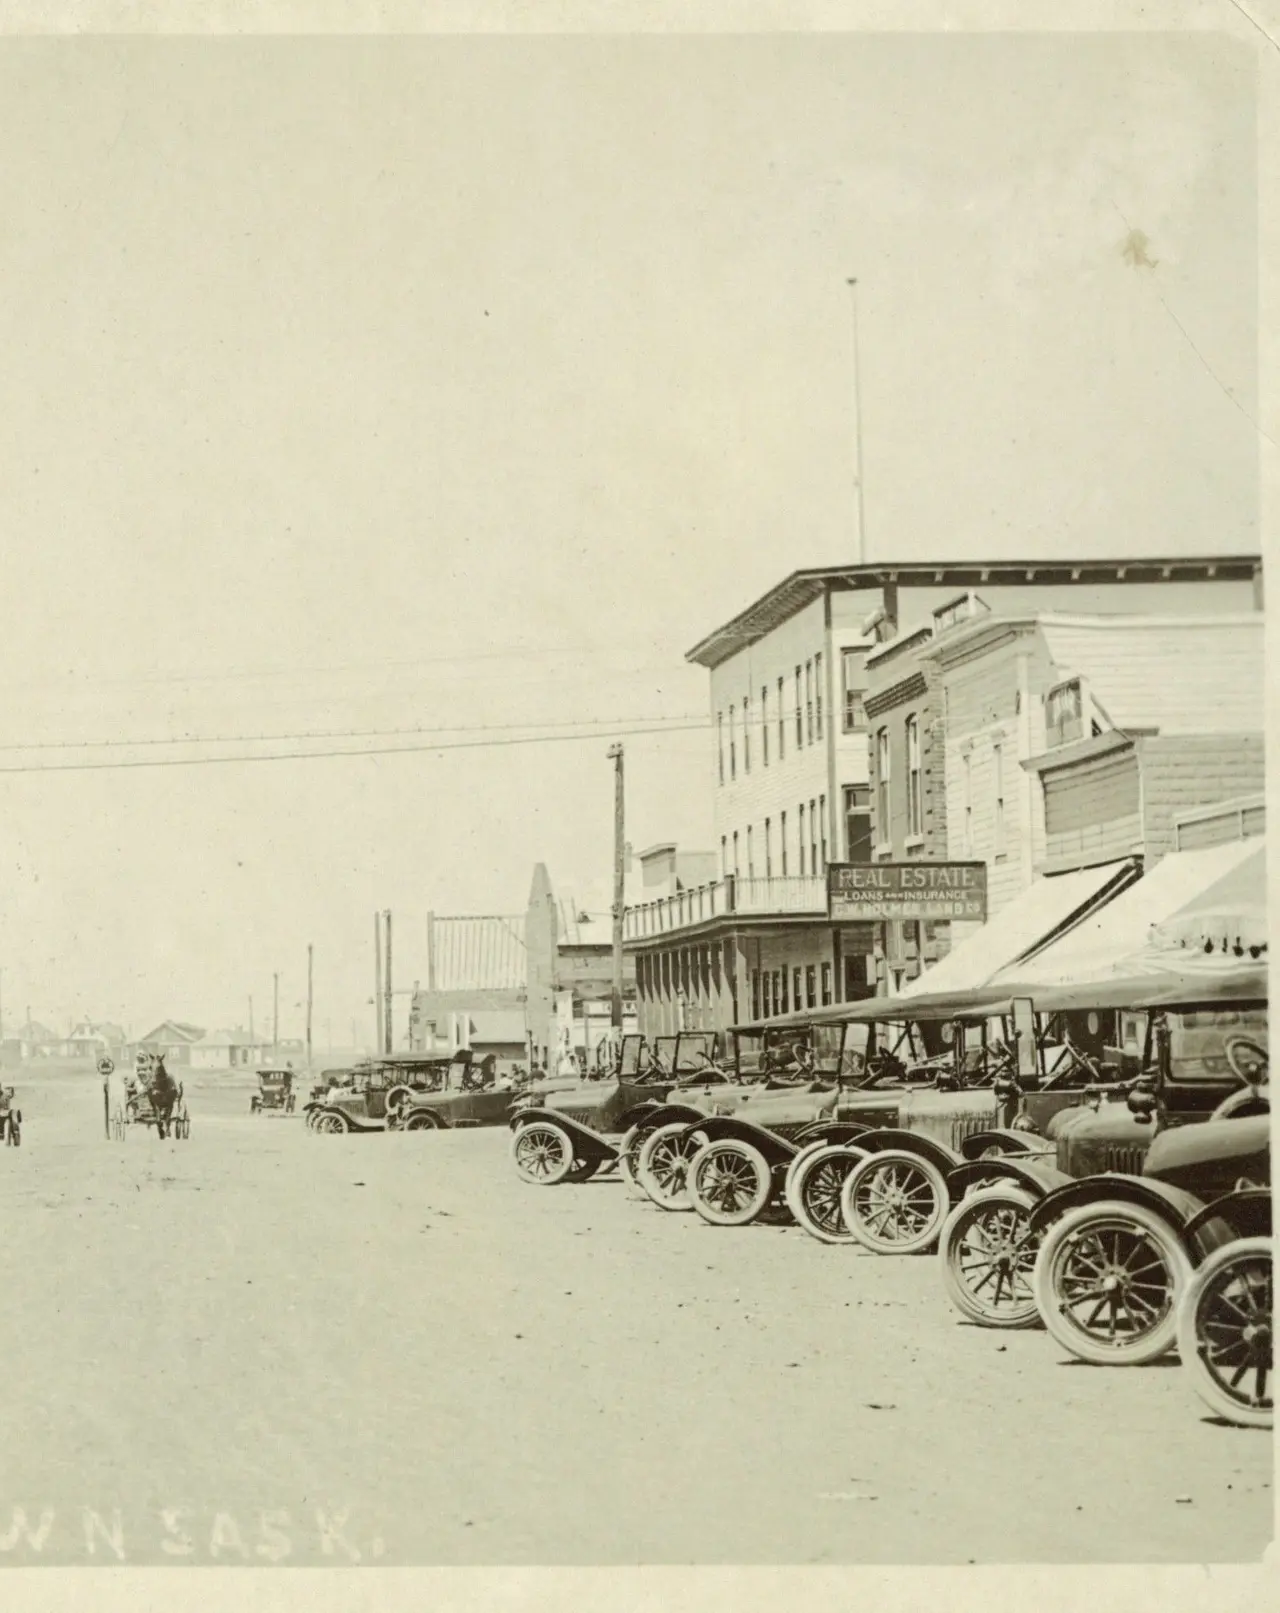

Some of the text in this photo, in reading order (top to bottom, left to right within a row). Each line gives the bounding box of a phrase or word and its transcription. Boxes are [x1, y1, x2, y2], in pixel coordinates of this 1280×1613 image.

[839, 867, 975, 888] REAL ESTATE
[843, 890, 883, 901] LOANS
[903, 889, 968, 901] INSURANCE
